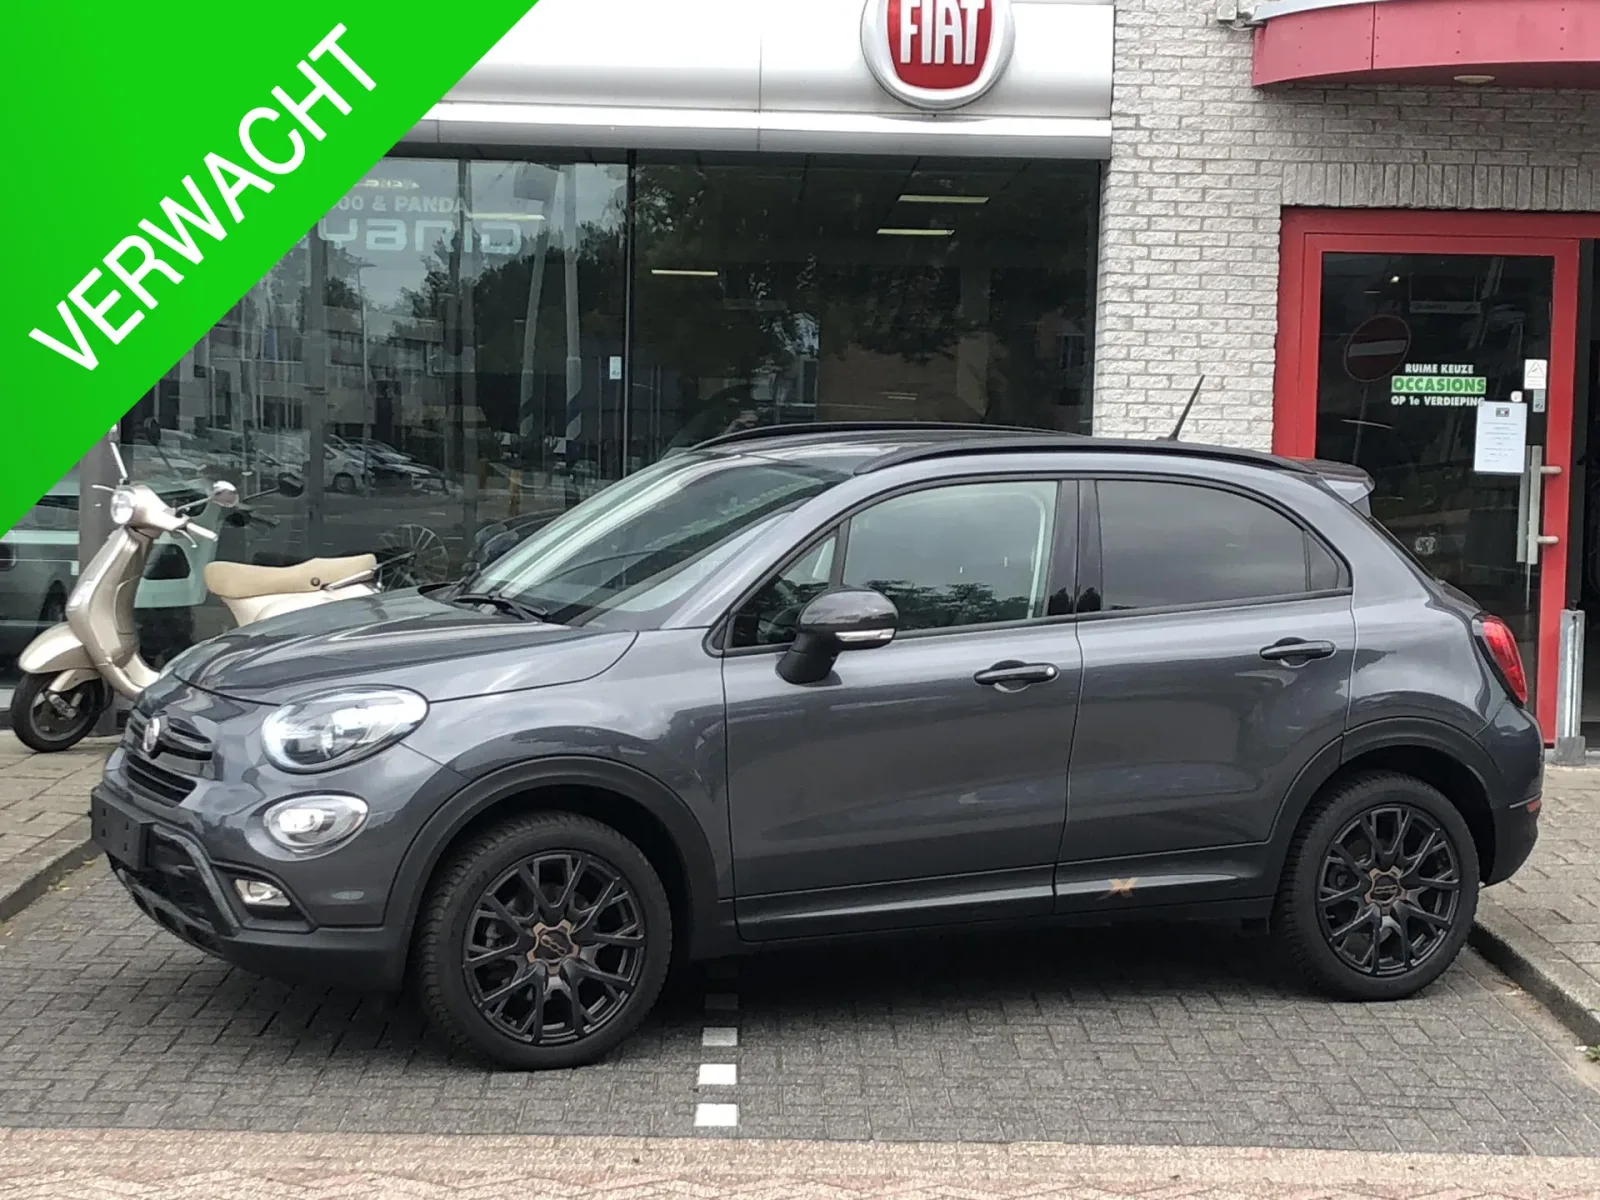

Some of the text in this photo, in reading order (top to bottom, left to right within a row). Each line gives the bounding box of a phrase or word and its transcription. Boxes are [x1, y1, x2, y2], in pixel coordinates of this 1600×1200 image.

[900, 0, 985, 65] FIAT
[333, 196, 467, 213] 00 & PANDA
[1405, 363, 1474, 374] RUIME KEUZE
[1393, 377, 1485, 392] OCCASIONS
[1391, 395, 1406, 405] OP
